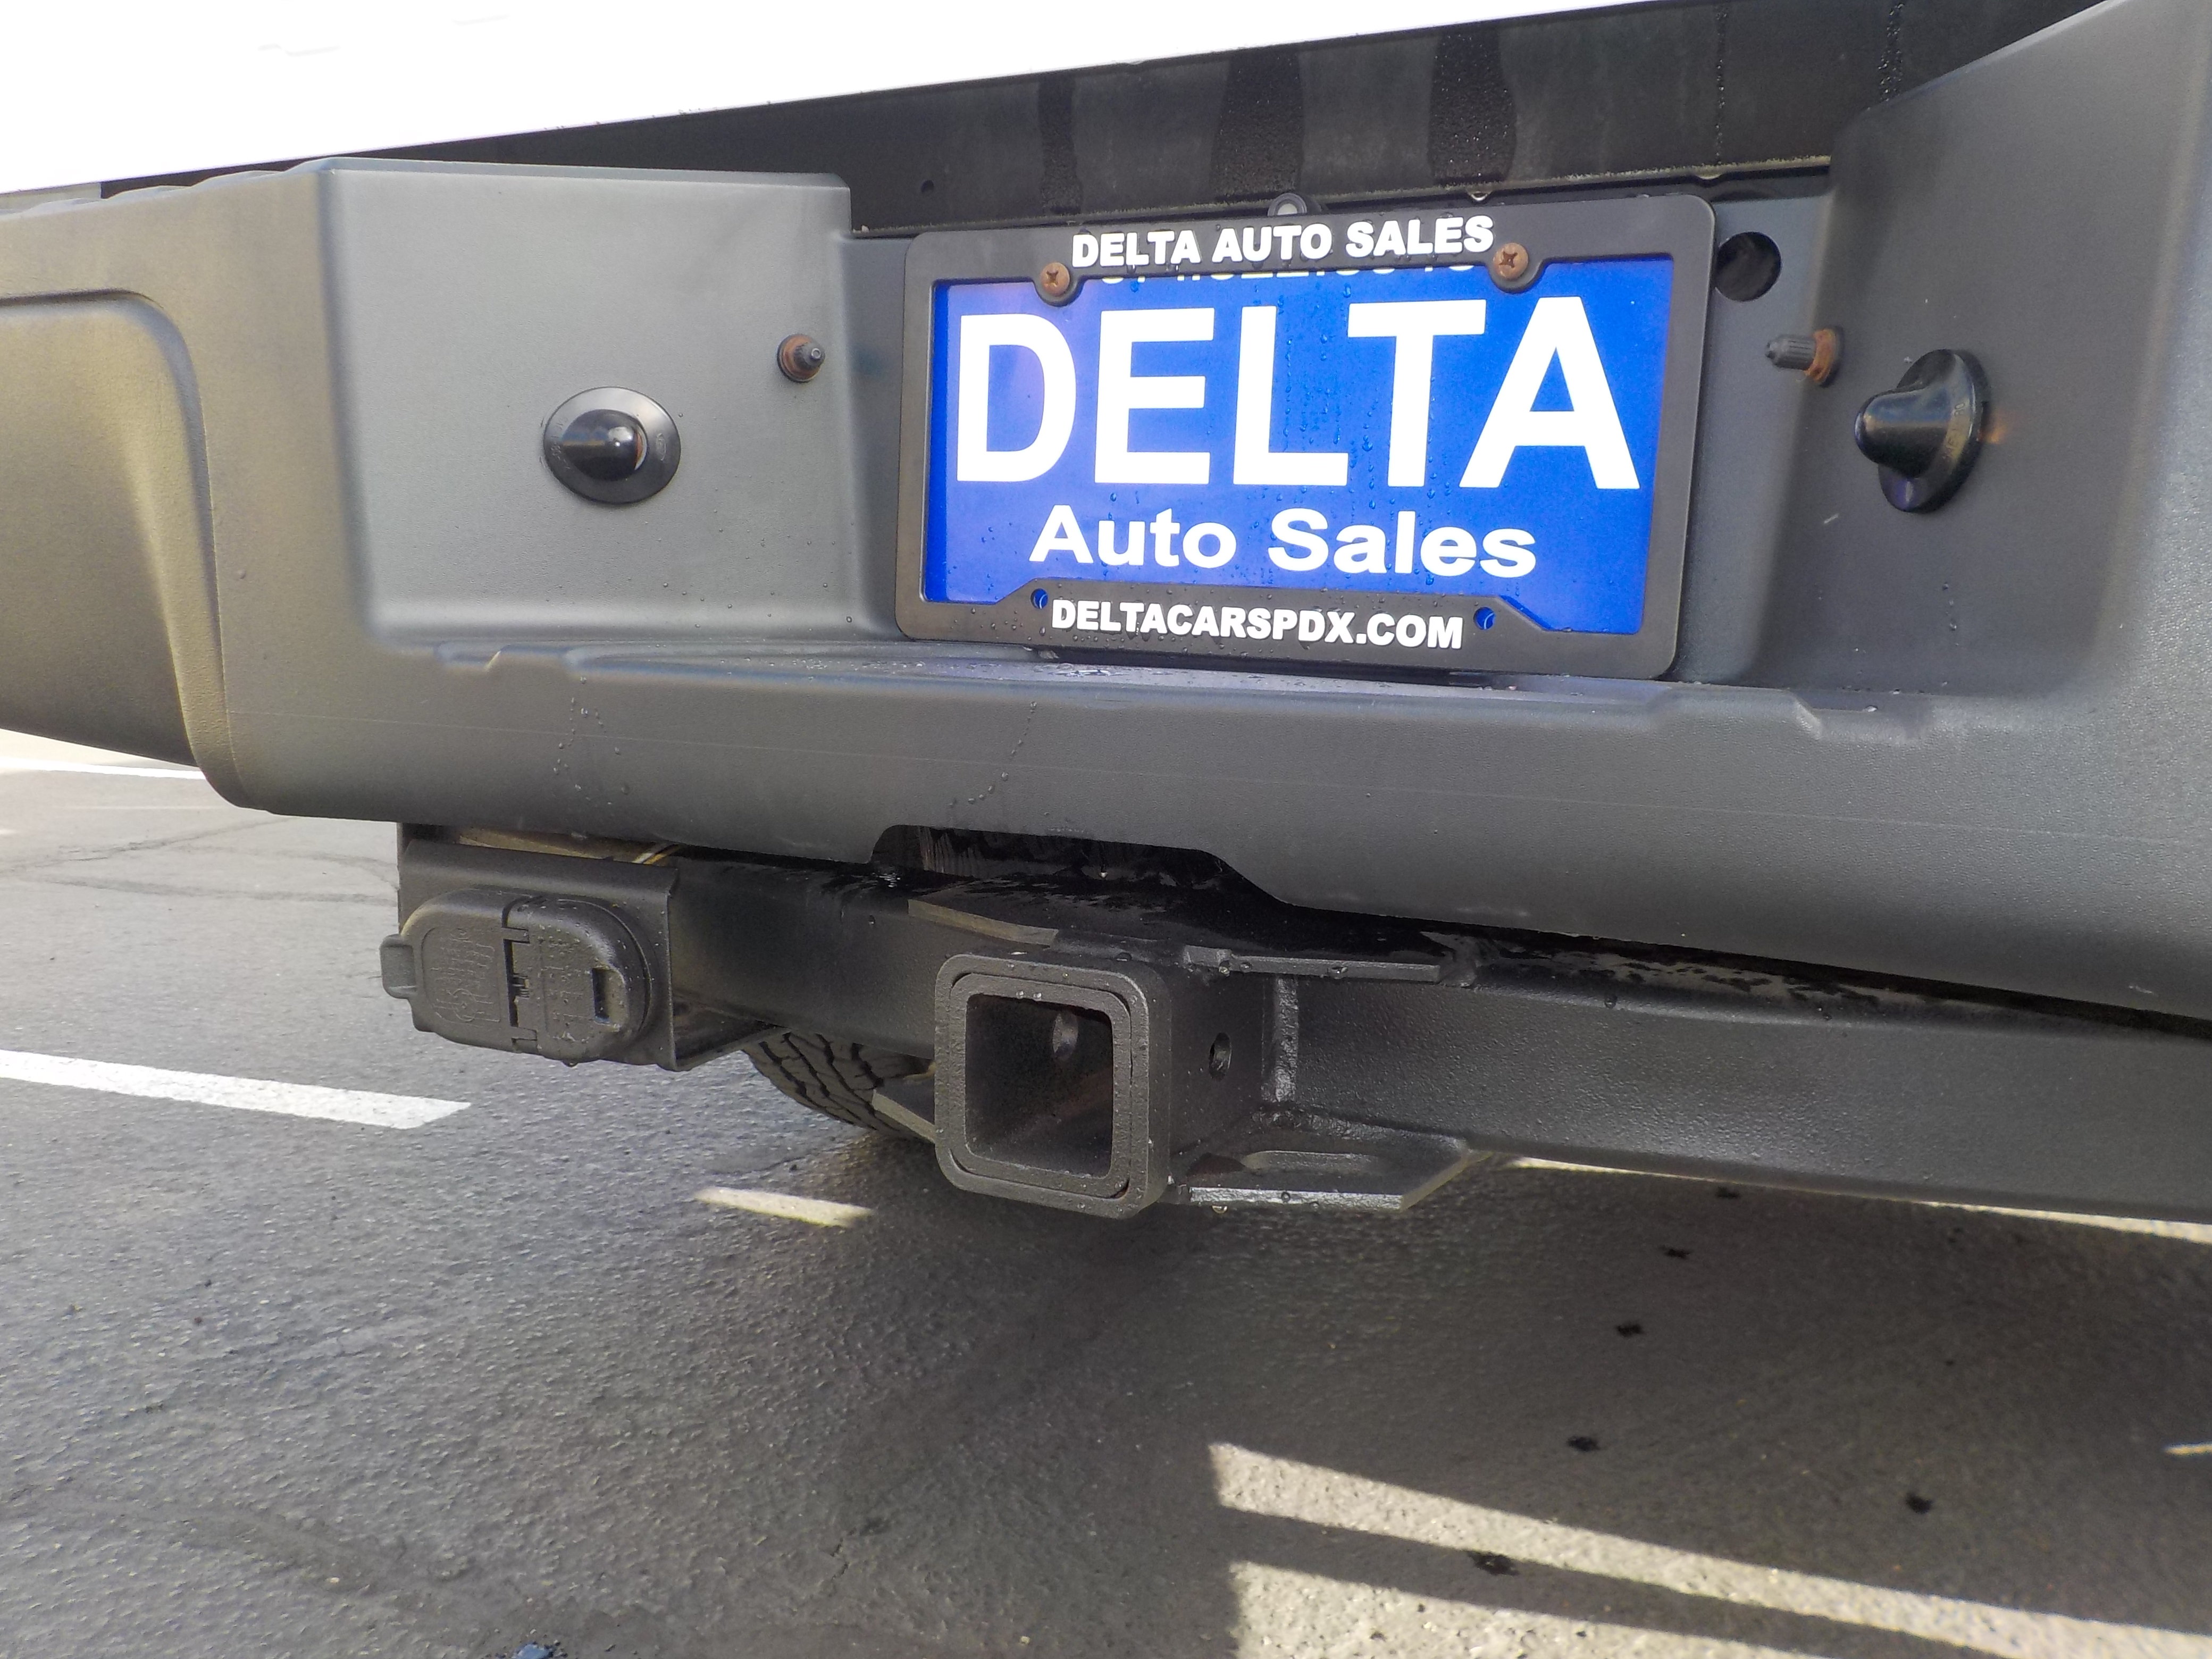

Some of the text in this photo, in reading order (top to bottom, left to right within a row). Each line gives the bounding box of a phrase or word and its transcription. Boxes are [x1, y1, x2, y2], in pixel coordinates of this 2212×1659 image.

[1071, 215, 1494, 268] DELTA AUTO SALES
[956, 296, 1640, 492] DELTA
[1029, 504, 1537, 579] Auto Sales
[1051, 599, 1463, 649] DELTACARSPDX.COM
